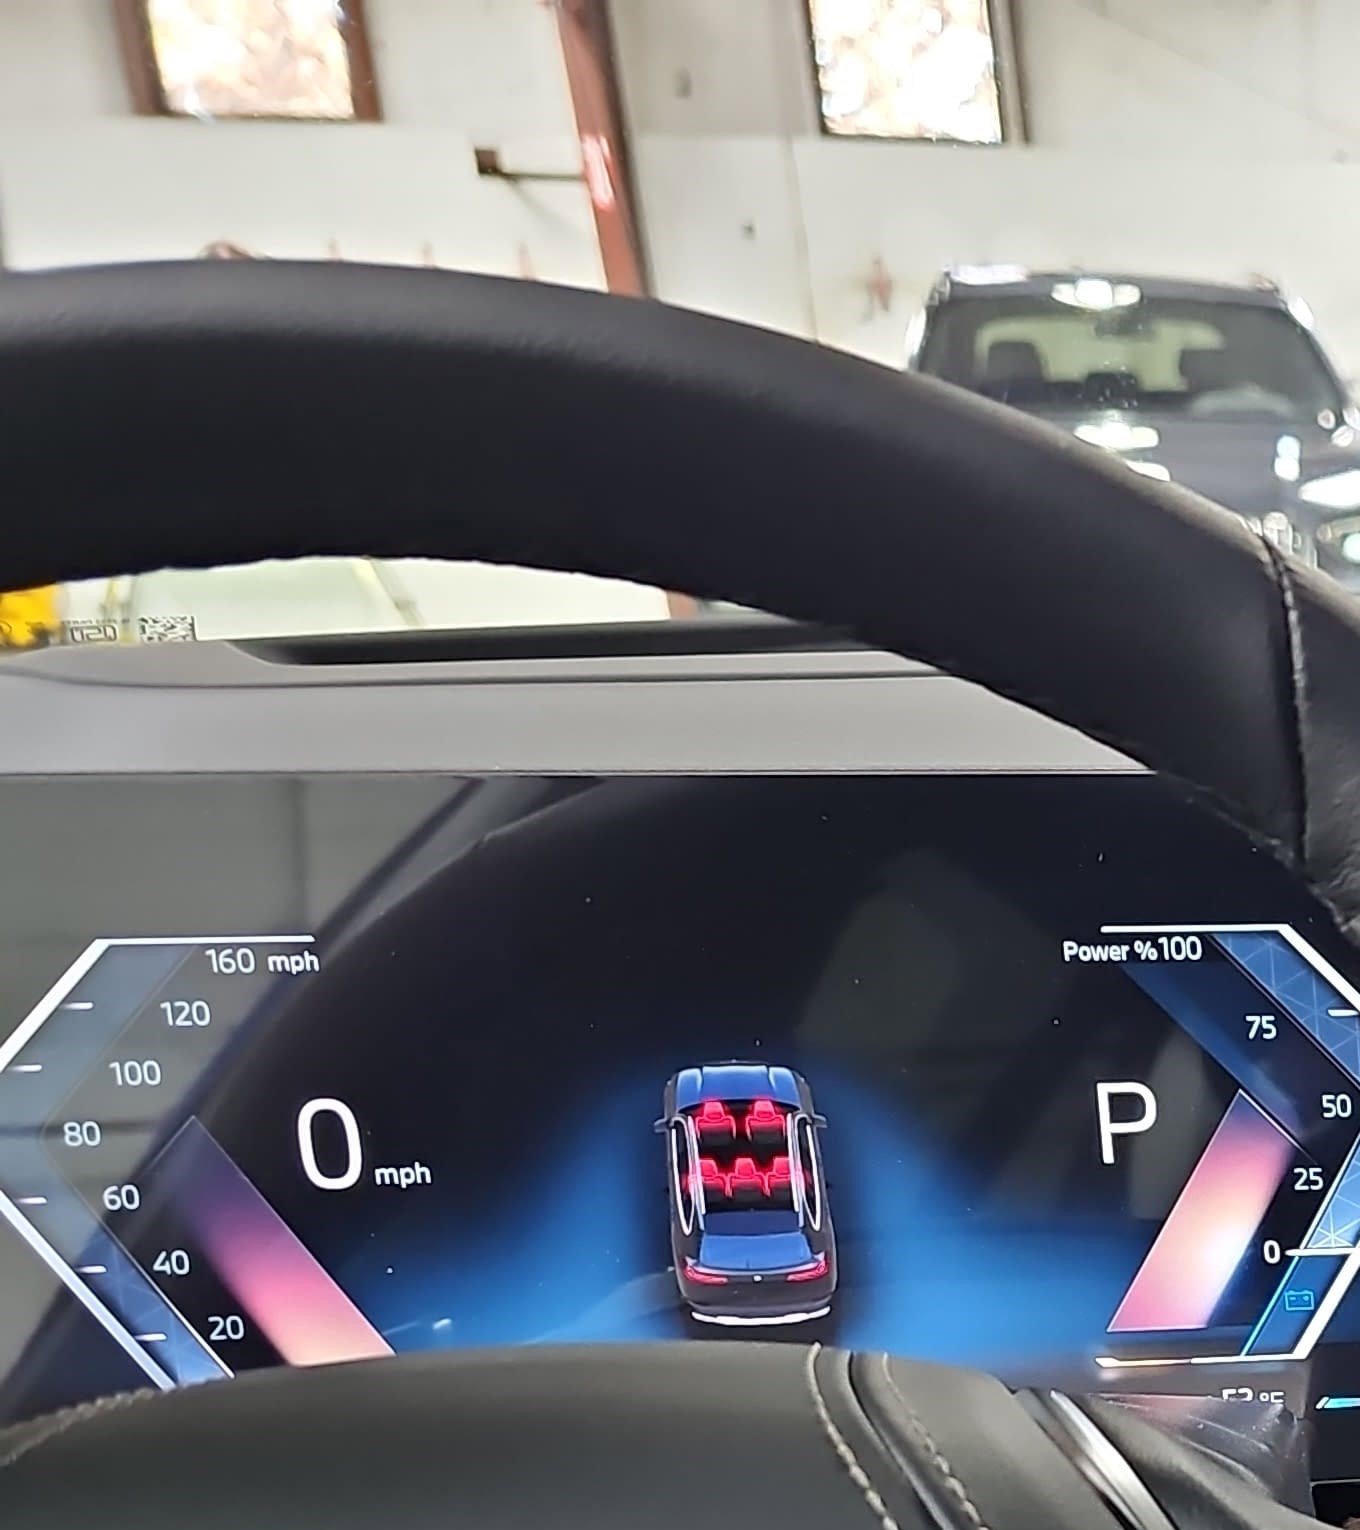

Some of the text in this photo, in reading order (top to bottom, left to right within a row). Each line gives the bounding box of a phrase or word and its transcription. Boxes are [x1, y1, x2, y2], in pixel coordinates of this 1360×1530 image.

[205, 948, 319, 975] 160 mph
[1063, 941, 1130, 961] Power
[161, 1001, 210, 1027] 120
[1245, 1015, 1277, 1040] 75
[110, 1061, 161, 1086] 100
[1322, 1094, 1352, 1119] 50
[64, 1122, 100, 1147] 80
[1095, 1082, 1157, 1165] P
[296, 1097, 431, 1191] 0 mph
[1294, 1167, 1323, 1191] 25
[103, 1185, 139, 1211] 60
[153, 1250, 189, 1276] 40
[1264, 1241, 1280, 1265] 0
[208, 1316, 244, 1340] 20
